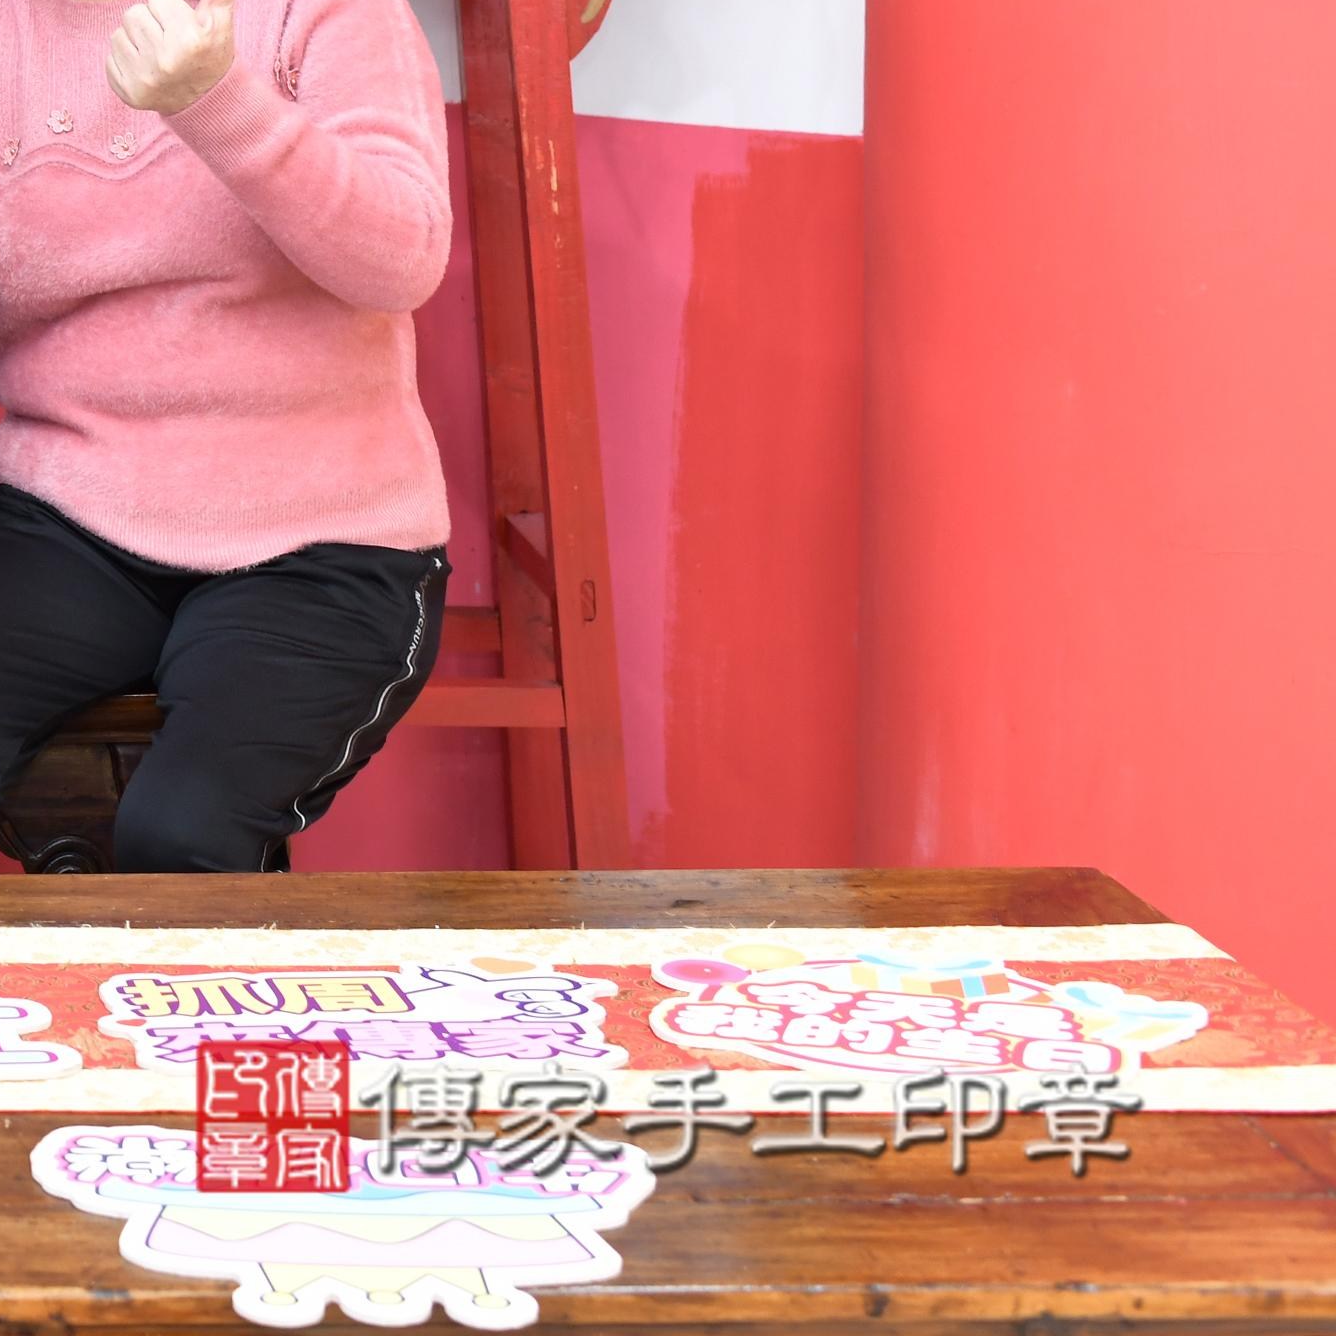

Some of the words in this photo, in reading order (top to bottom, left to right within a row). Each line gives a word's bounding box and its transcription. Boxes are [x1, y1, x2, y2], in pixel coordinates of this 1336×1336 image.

[119, 976, 415, 1017] 抓周
[743, 983, 1080, 1042] 今天是
[671, 1003, 1115, 1071] 我的生日
